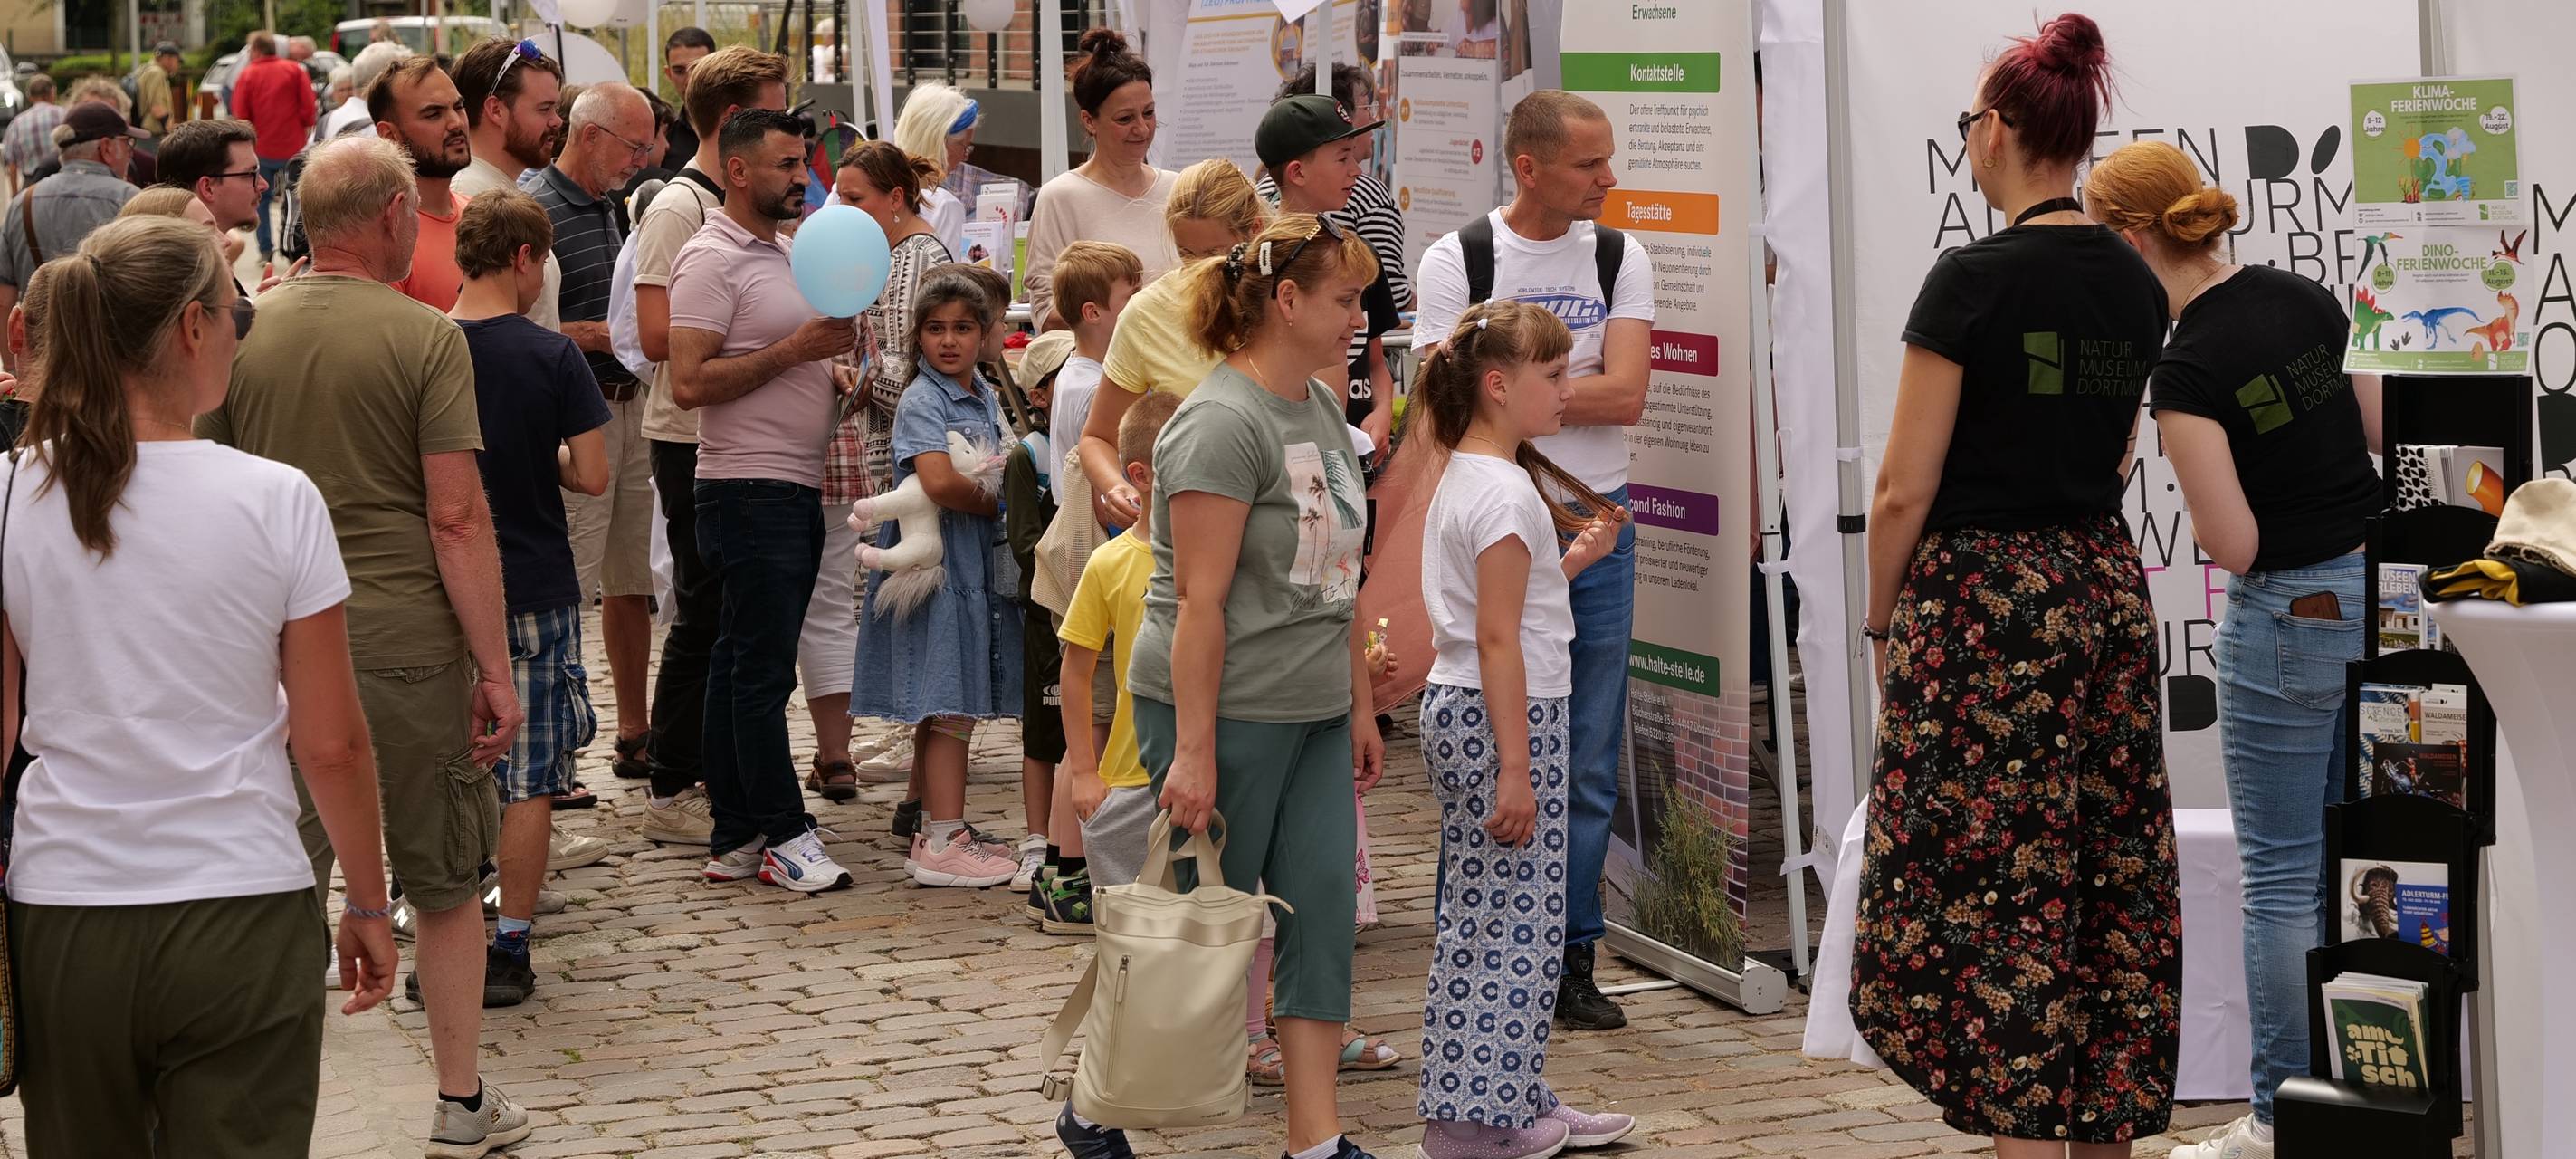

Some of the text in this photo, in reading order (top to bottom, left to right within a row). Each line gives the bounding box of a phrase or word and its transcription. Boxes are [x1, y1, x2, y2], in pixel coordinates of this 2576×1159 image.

[1632, 4, 1676, 20] Erwachsene
[1630, 63, 1684, 81] Kontaktstelle
[2412, 85, 2455, 99] KLIMA-
[1629, 104, 1639, 116] Der
[1654, 104, 1679, 118] Treffpunkt
[1680, 104, 1688, 116] für
[1688, 104, 1709, 119] psychisch
[2390, 97, 2477, 112] FERIENWOCHE
[1628, 122, 1712, 136] erkrankte und belastete Erwachsene,
[2364, 125, 2385, 133] Jahre
[2485, 122, 2509, 131] August
[1628, 139, 1637, 150] die
[1637, 139, 1657, 154] Beratung,
[1658, 139, 1685, 154] Akzeptanz
[1685, 141, 1695, 152] und
[1652, 158, 1684, 171] Atmosphäre
[1626, 201, 1672, 224] Tagesstätte
[1649, 243, 1686, 259] Stabilisierung,
[1686, 245, 1712, 258] individuelle
[2421, 244, 2459, 257] DINO-
[1657, 261, 1699, 278] Neuorientierung
[1698, 263, 1712, 275] durch
[2397, 257, 2487, 271] FERIENWOCHE
[1660, 279, 1696, 293] Gemeinschaft
[1696, 282, 1705, 293] und
[2485, 278, 2513, 286] August
[1673, 298, 1697, 312] Angebote.
[1663, 342, 1698, 363] Wohnen
[2080, 340, 2132, 358] NATUR
[2079, 359, 2147, 377] MUSEUM
[2285, 343, 2330, 378] NATUR
[1653, 382, 1662, 393] auf
[1662, 383, 1671, 394] die
[1672, 383, 1701, 398] Bedürfnisse
[1701, 387, 1711, 399] des
[2302, 373, 2351, 412] DORTMU
[1677, 402, 1713, 420] Unterstützung,
[1661, 418, 1672, 430] und
[1673, 419, 1714, 436] eigenverantwort-
[1634, 434, 1643, 444] der
[1643, 435, 1664, 448] eigenen
[1664, 436, 1689, 453] Wohnung
[1689, 439, 1703, 452] leben
[1703, 444, 1710, 454] zu
[1629, 496, 1686, 520] cond Fashion
[1657, 539, 1684, 554] berufliche
[1684, 542, 1710, 561] Förderung,
[1639, 554, 1668, 569] preiswerter
[1668, 560, 1678, 570] und
[1679, 560, 1709, 579] neuwertiger
[1648, 574, 1670, 586] unserem
[1671, 576, 1699, 592] Ladenlokal.
[2379, 581, 2417, 594] RLEBEN
[1629, 654, 1705, 684] www.halte-stelle.de
[1043, 696, 1062, 706] PUM
[2425, 711, 2466, 722] WALDAMEISE
[2361, 1064, 2417, 1087] sch
